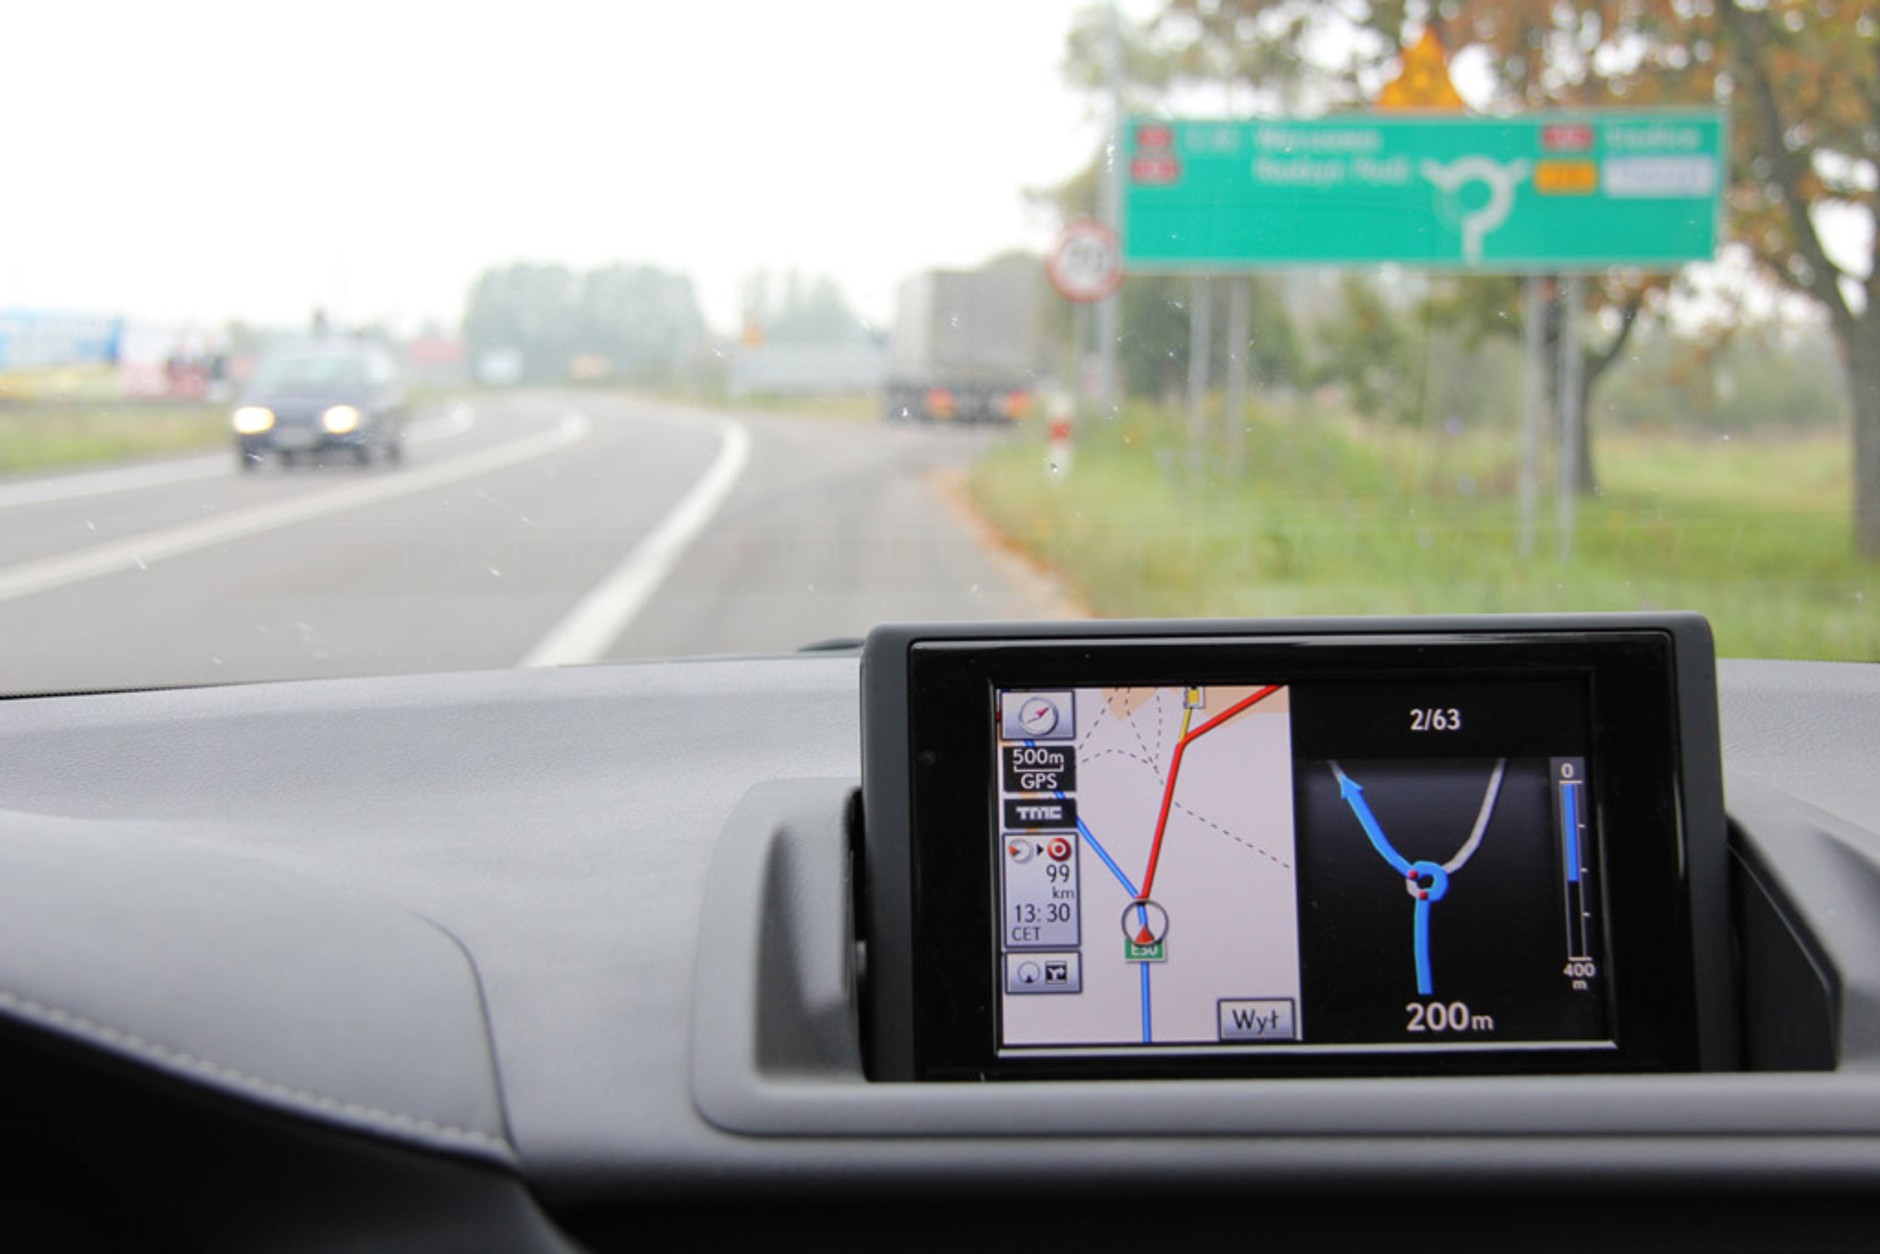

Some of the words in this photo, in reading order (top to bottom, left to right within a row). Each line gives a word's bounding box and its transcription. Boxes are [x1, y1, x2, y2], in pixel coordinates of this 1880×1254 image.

[1410, 708, 1462, 731] 2/63
[1013, 749, 1064, 765] 500m
[1560, 763, 1575, 778] 0
[1020, 773, 1058, 789] GPS
[1016, 806, 1062, 820] TMC
[1046, 864, 1070, 883] 99
[1052, 886, 1075, 899] km
[1012, 926, 1041, 941] CET
[1563, 963, 1596, 977] 400
[1572, 979, 1588, 990] m
[1232, 1008, 1279, 1034] Wył
